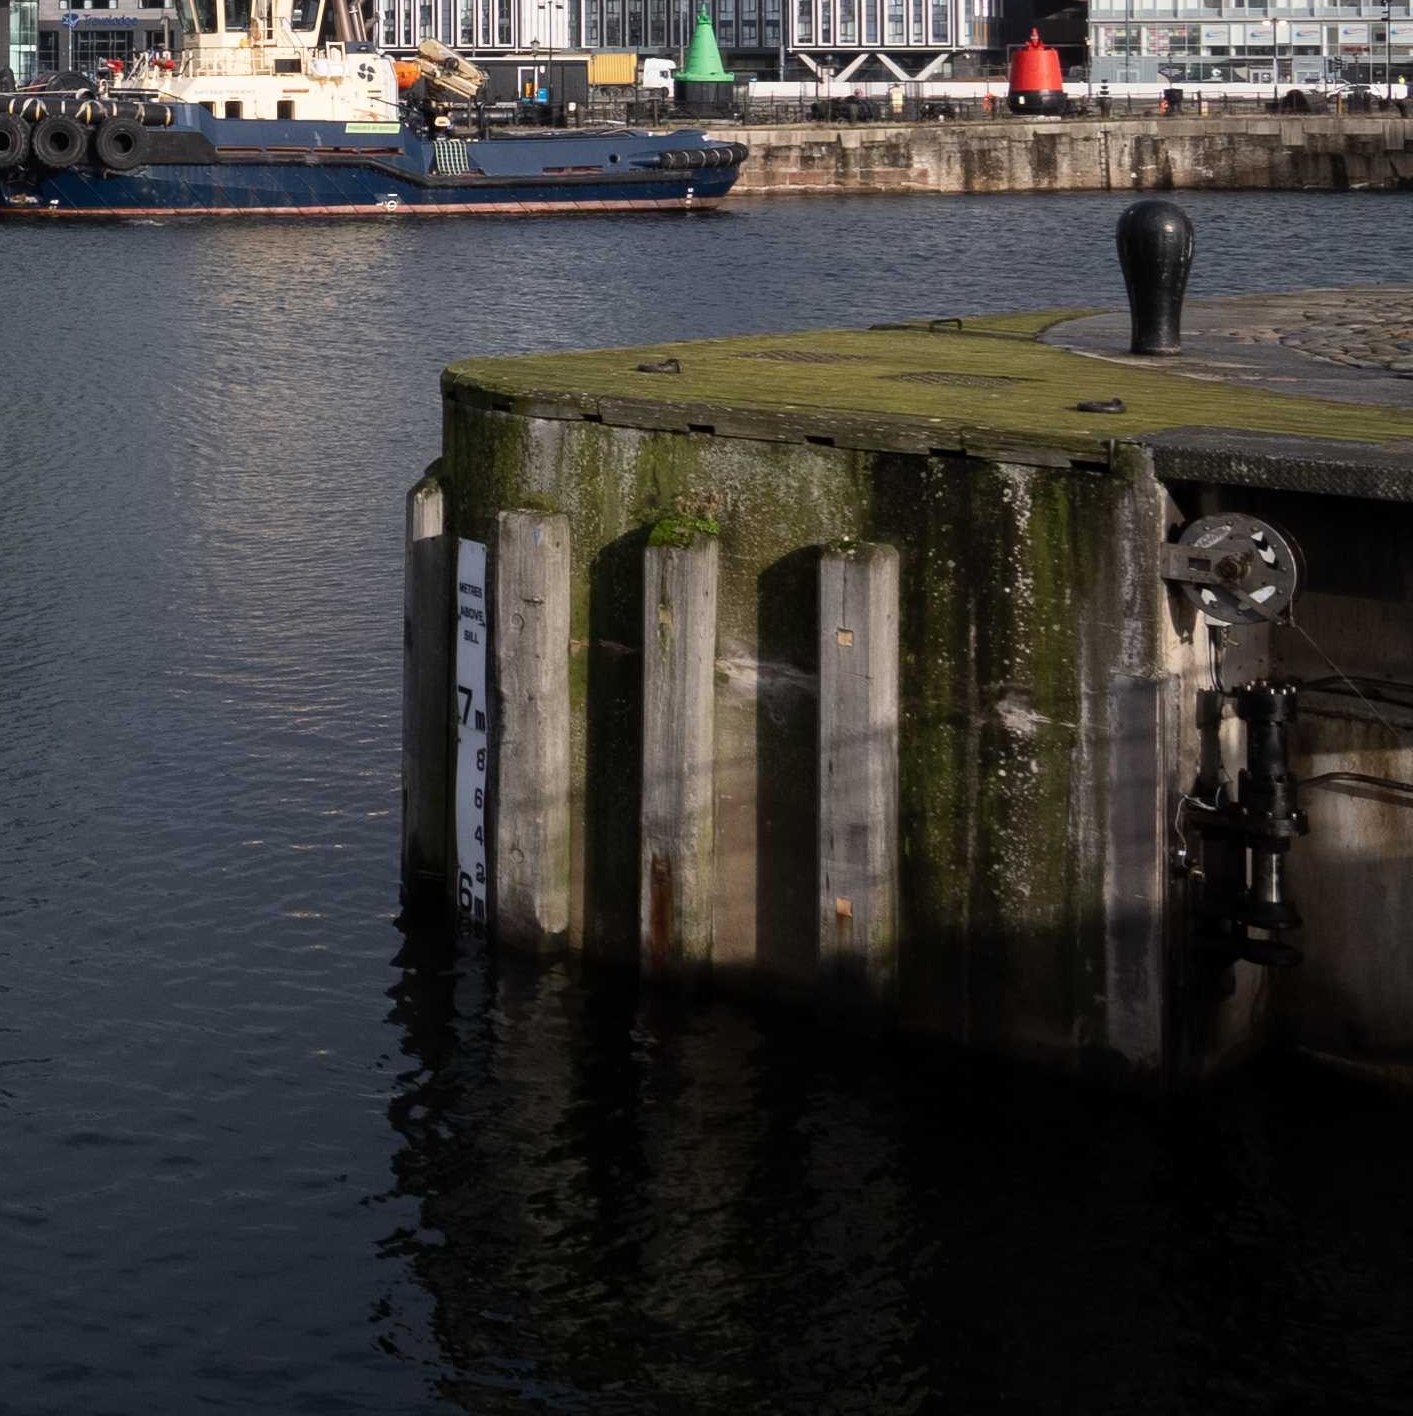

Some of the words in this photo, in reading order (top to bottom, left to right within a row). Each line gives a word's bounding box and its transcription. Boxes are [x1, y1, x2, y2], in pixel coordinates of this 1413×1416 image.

[460, 582, 482, 599] METRES
[461, 605, 484, 622] ABOVE
[464, 630, 479, 645] SILL
[476, 748, 485, 771] 8
[474, 788, 483, 809] 6
[474, 825, 483, 846] 4
[475, 862, 485, 884] 2
